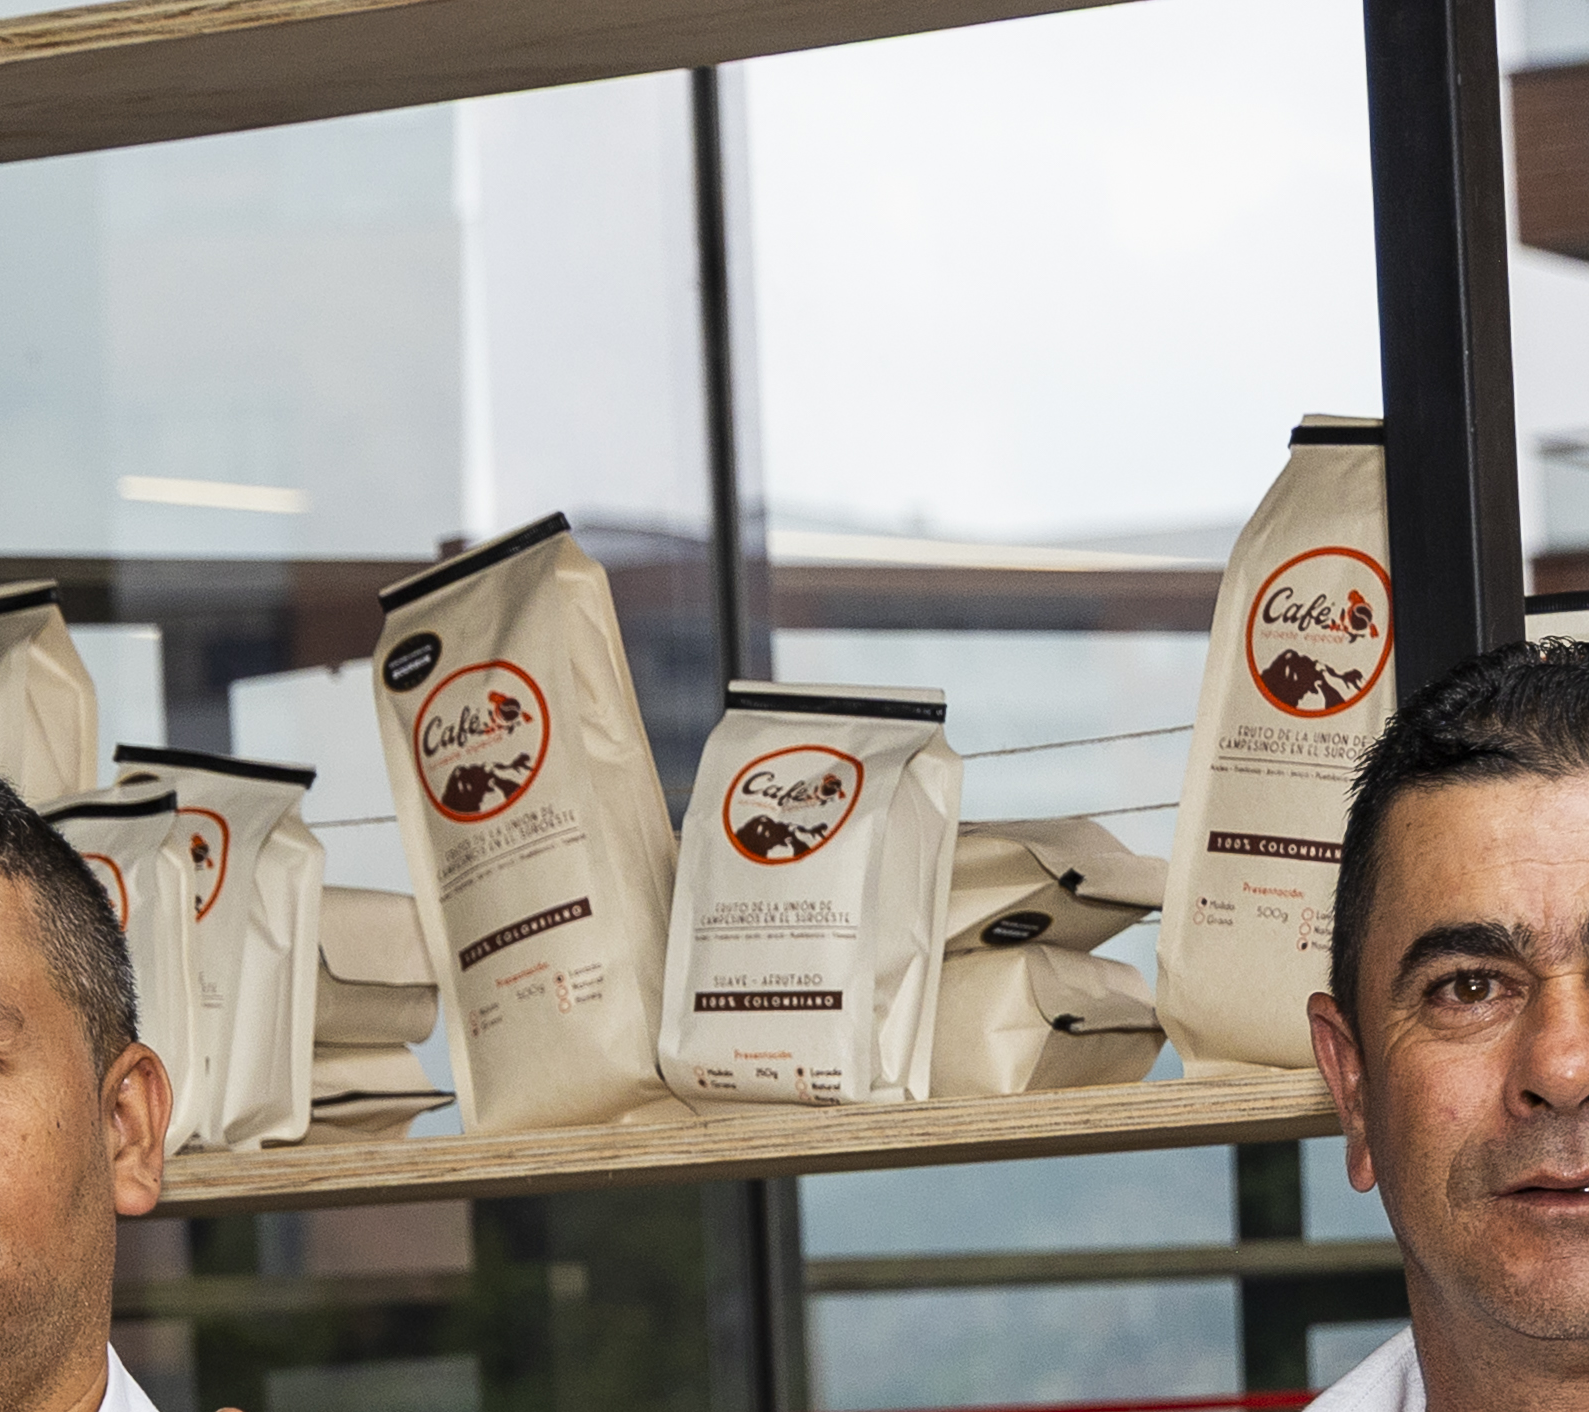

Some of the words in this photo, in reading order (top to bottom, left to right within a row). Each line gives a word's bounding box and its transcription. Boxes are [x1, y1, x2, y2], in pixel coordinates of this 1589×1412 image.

[1262, 587, 1336, 631] Café
[423, 705, 482, 758] Café
[1238, 725, 1274, 740] FRUTO
[1278, 728, 1291, 741] DE
[1295, 730, 1308, 742] LA
[1353, 735, 1368, 747] DE
[1218, 736, 1286, 755] CAMPESINOS
[1290, 742, 1304, 755] EN
[1308, 744, 1319, 756] EL
[1217, 837, 1251, 851] 100%
[1257, 906, 1289, 924] 500g
[713, 974, 747, 987] SUAVE
[761, 973, 823, 986] AFRUTADO
[702, 996, 736, 1008] 100%
[743, 995, 834, 1008] COLOMBIANO
